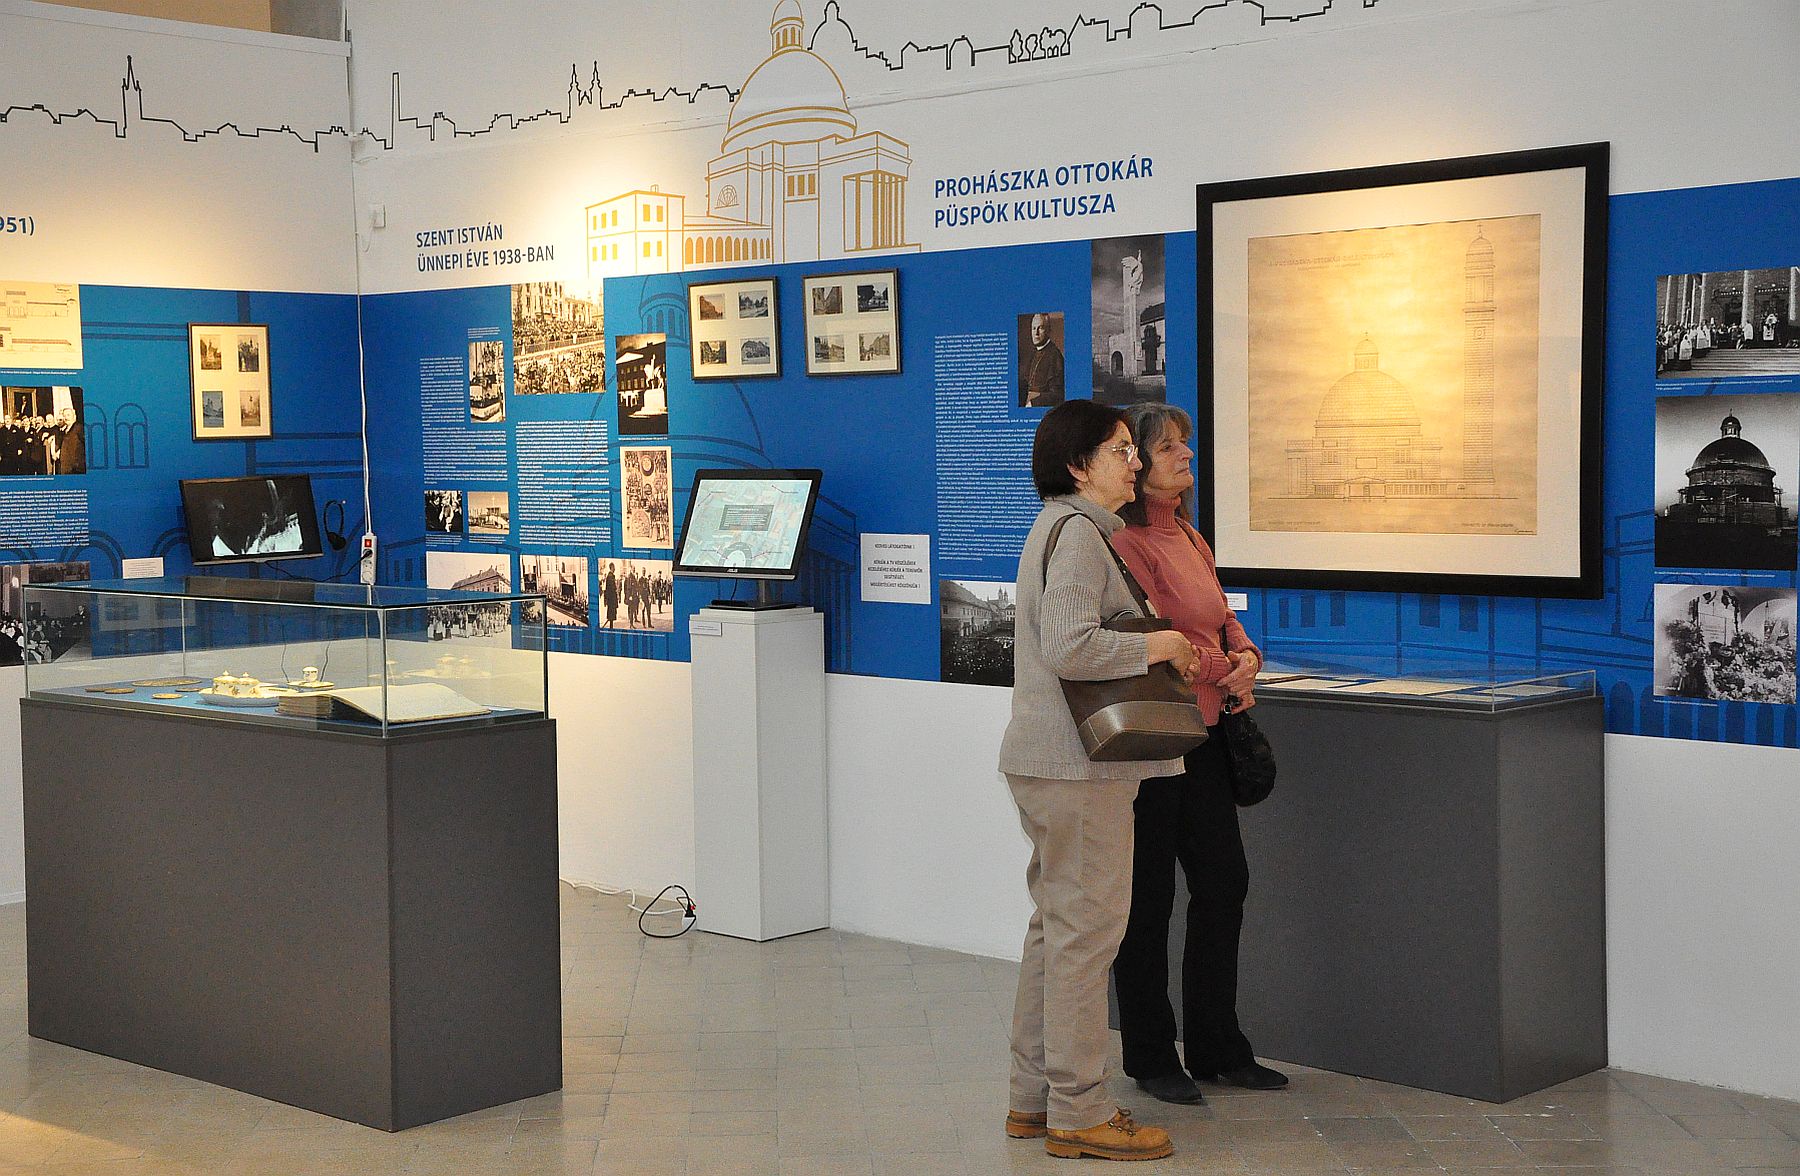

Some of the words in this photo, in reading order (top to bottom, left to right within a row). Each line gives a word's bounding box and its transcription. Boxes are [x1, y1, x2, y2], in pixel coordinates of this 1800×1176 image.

[935, 169, 1049, 199] PROHÁSZKA
[1055, 154, 1153, 186] OTTOKÁR
[935, 200, 1009, 228] PÜSPÖK
[1014, 193, 1116, 221] KULTUSZA
[416, 229, 455, 248] SZENT
[457, 222, 503, 244] ISTVÁN
[417, 253, 463, 272] ÜNNEPI
[466, 249, 489, 268] ÉVE
[493, 244, 555, 266] 1938-BAN
